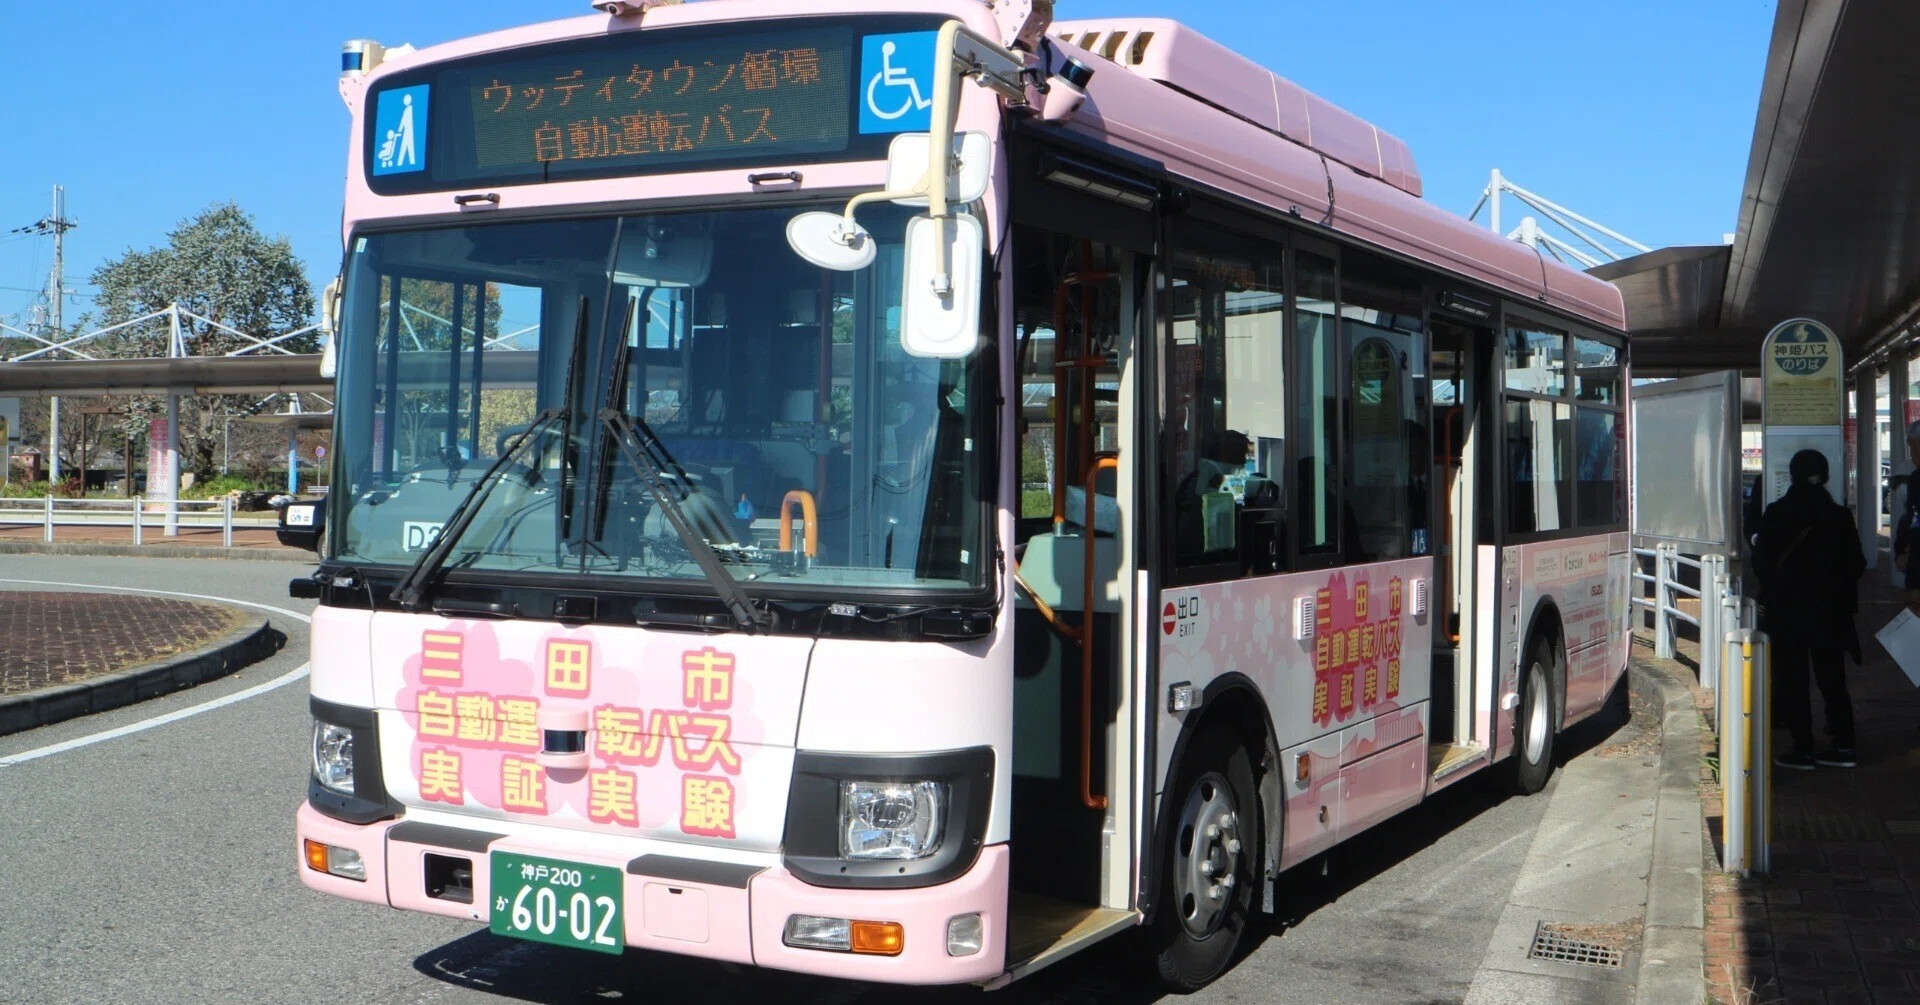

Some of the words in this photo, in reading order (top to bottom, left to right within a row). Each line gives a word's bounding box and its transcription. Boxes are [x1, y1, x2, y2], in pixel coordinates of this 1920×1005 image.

[483, 47, 820, 113] ウッディタウン循環
[535, 107, 778, 163] 自動運転バス
[1774, 344, 1828, 356] 神姫バス
[1782, 358, 1820, 370] のりば
[1178, 596, 1198, 619] 出口
[1180, 622, 1195, 637] EXIT
[1316, 578, 1401, 627] 三田市
[421, 631, 734, 707] 三田市
[1316, 619, 1400, 673] 自動運転バス
[1313, 659, 1400, 719] 実証実験
[417, 690, 739, 770] 自動運転バス
[420, 750, 734, 834] 実証実験
[496, 896, 509, 912] か
[512, 885, 616, 946] 60-02
